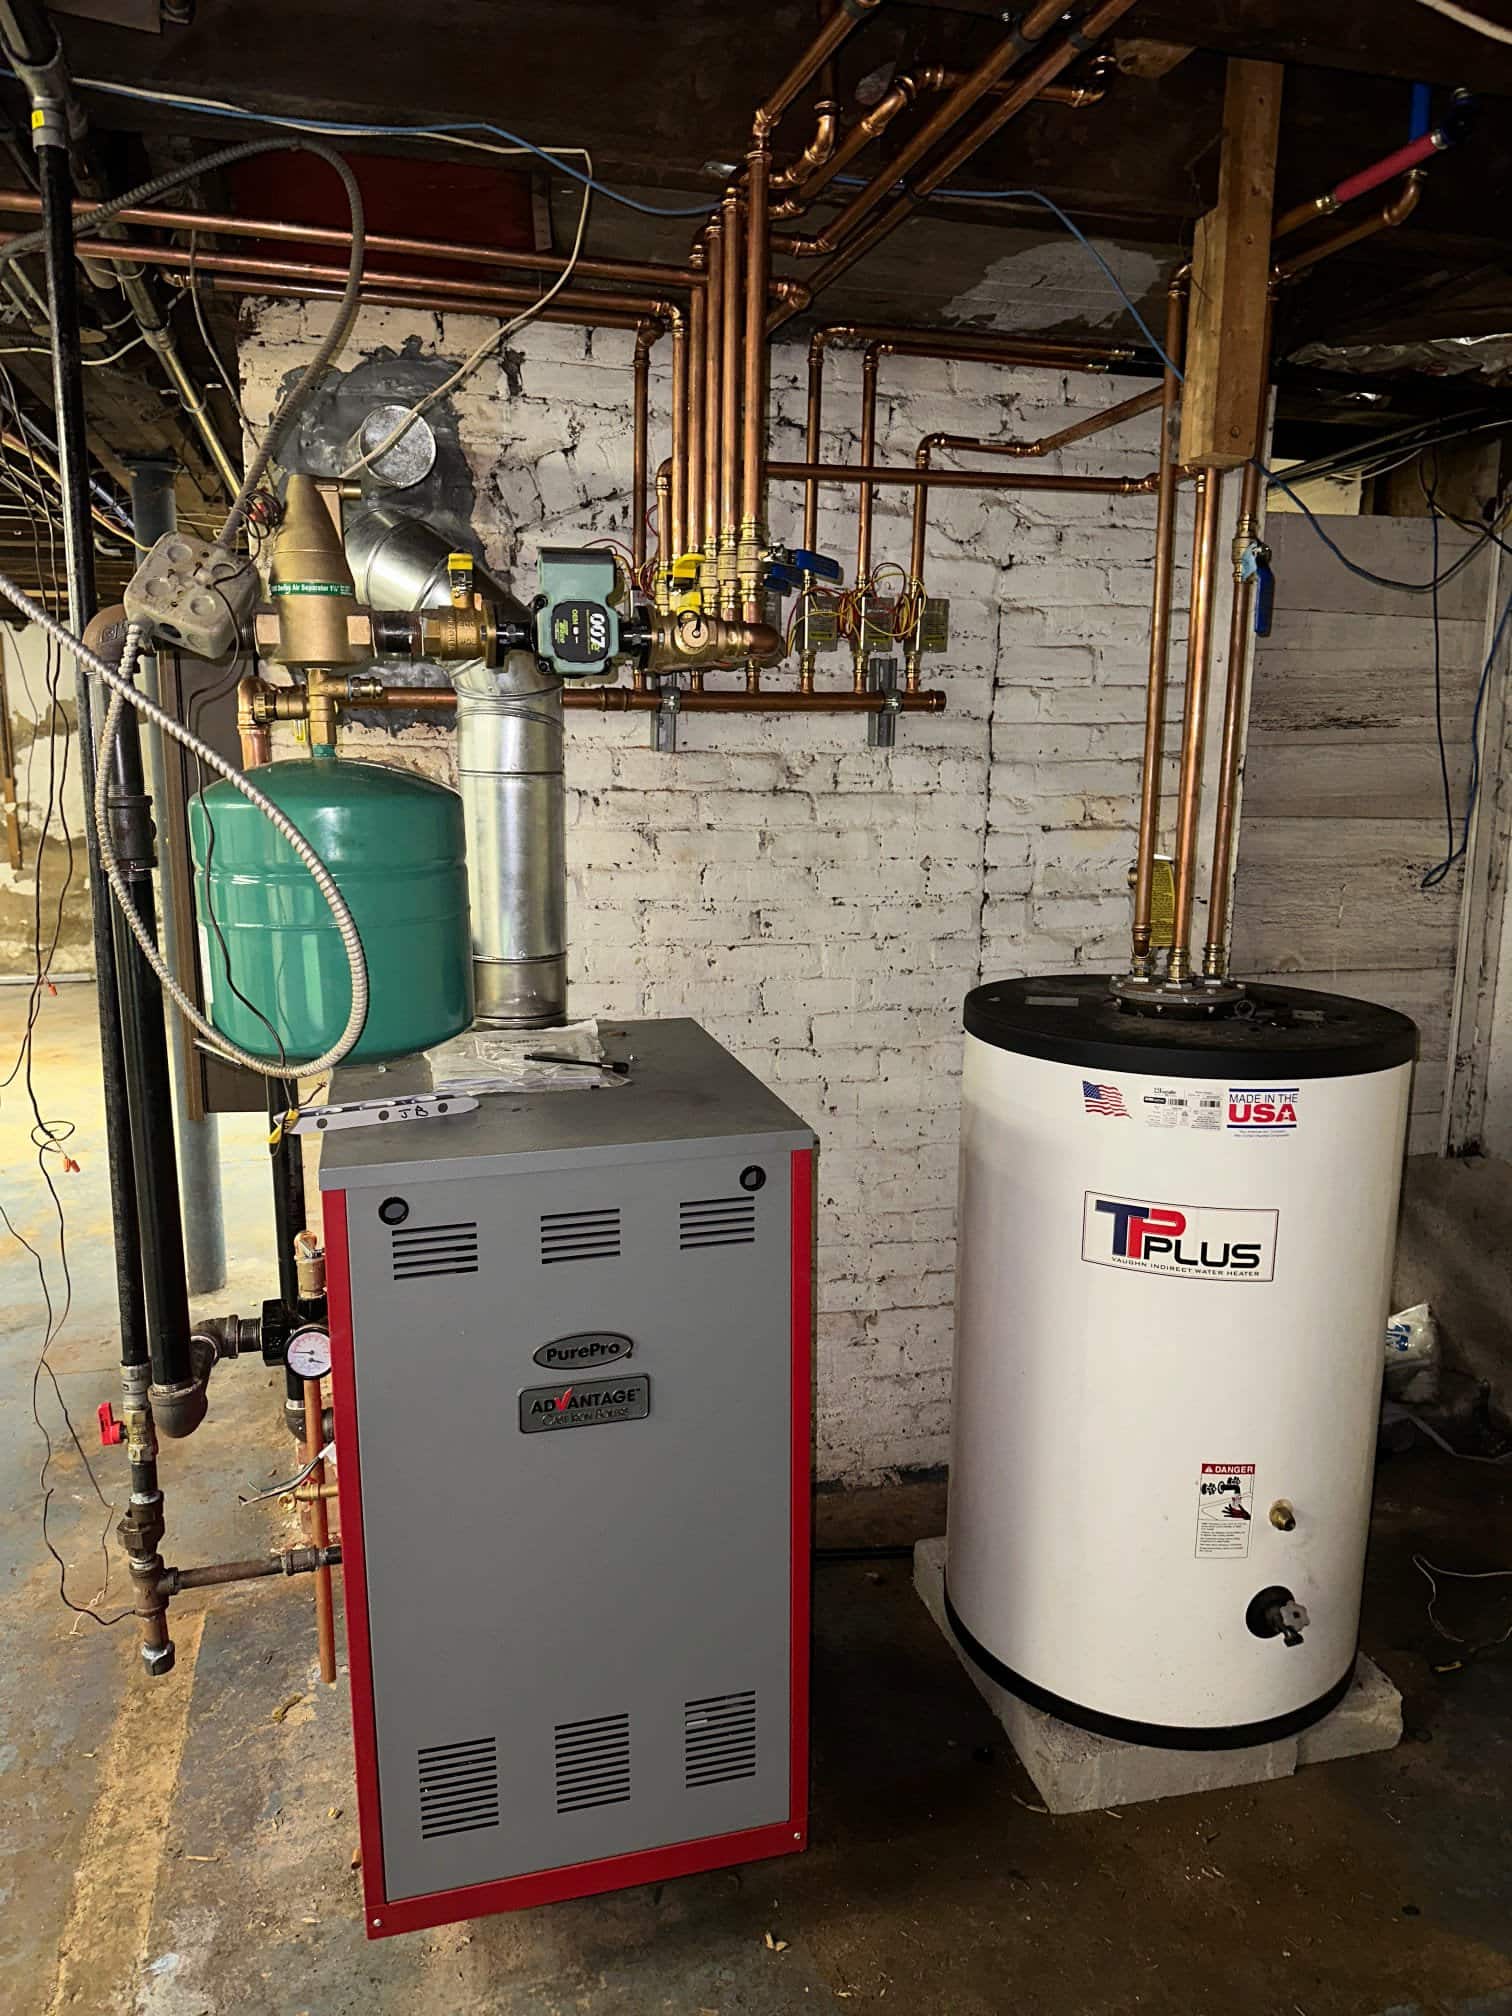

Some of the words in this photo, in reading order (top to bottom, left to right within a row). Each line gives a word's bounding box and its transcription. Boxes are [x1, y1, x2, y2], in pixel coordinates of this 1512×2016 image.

[1229, 1094, 1261, 1104] MADE
[1264, 1094, 1276, 1104] IN
[1278, 1093, 1299, 1104] THE
[1228, 1103, 1297, 1123] USA
[1111, 1256, 1148, 1267] VAUGHN
[1150, 1263, 1193, 1274] INDIRECT
[1194, 1268, 1224, 1276] WATER
[546, 1342, 621, 1362] PurePro
[531, 1387, 637, 1415] ADVANTAGE
[1215, 1466, 1254, 1474] DANGER
